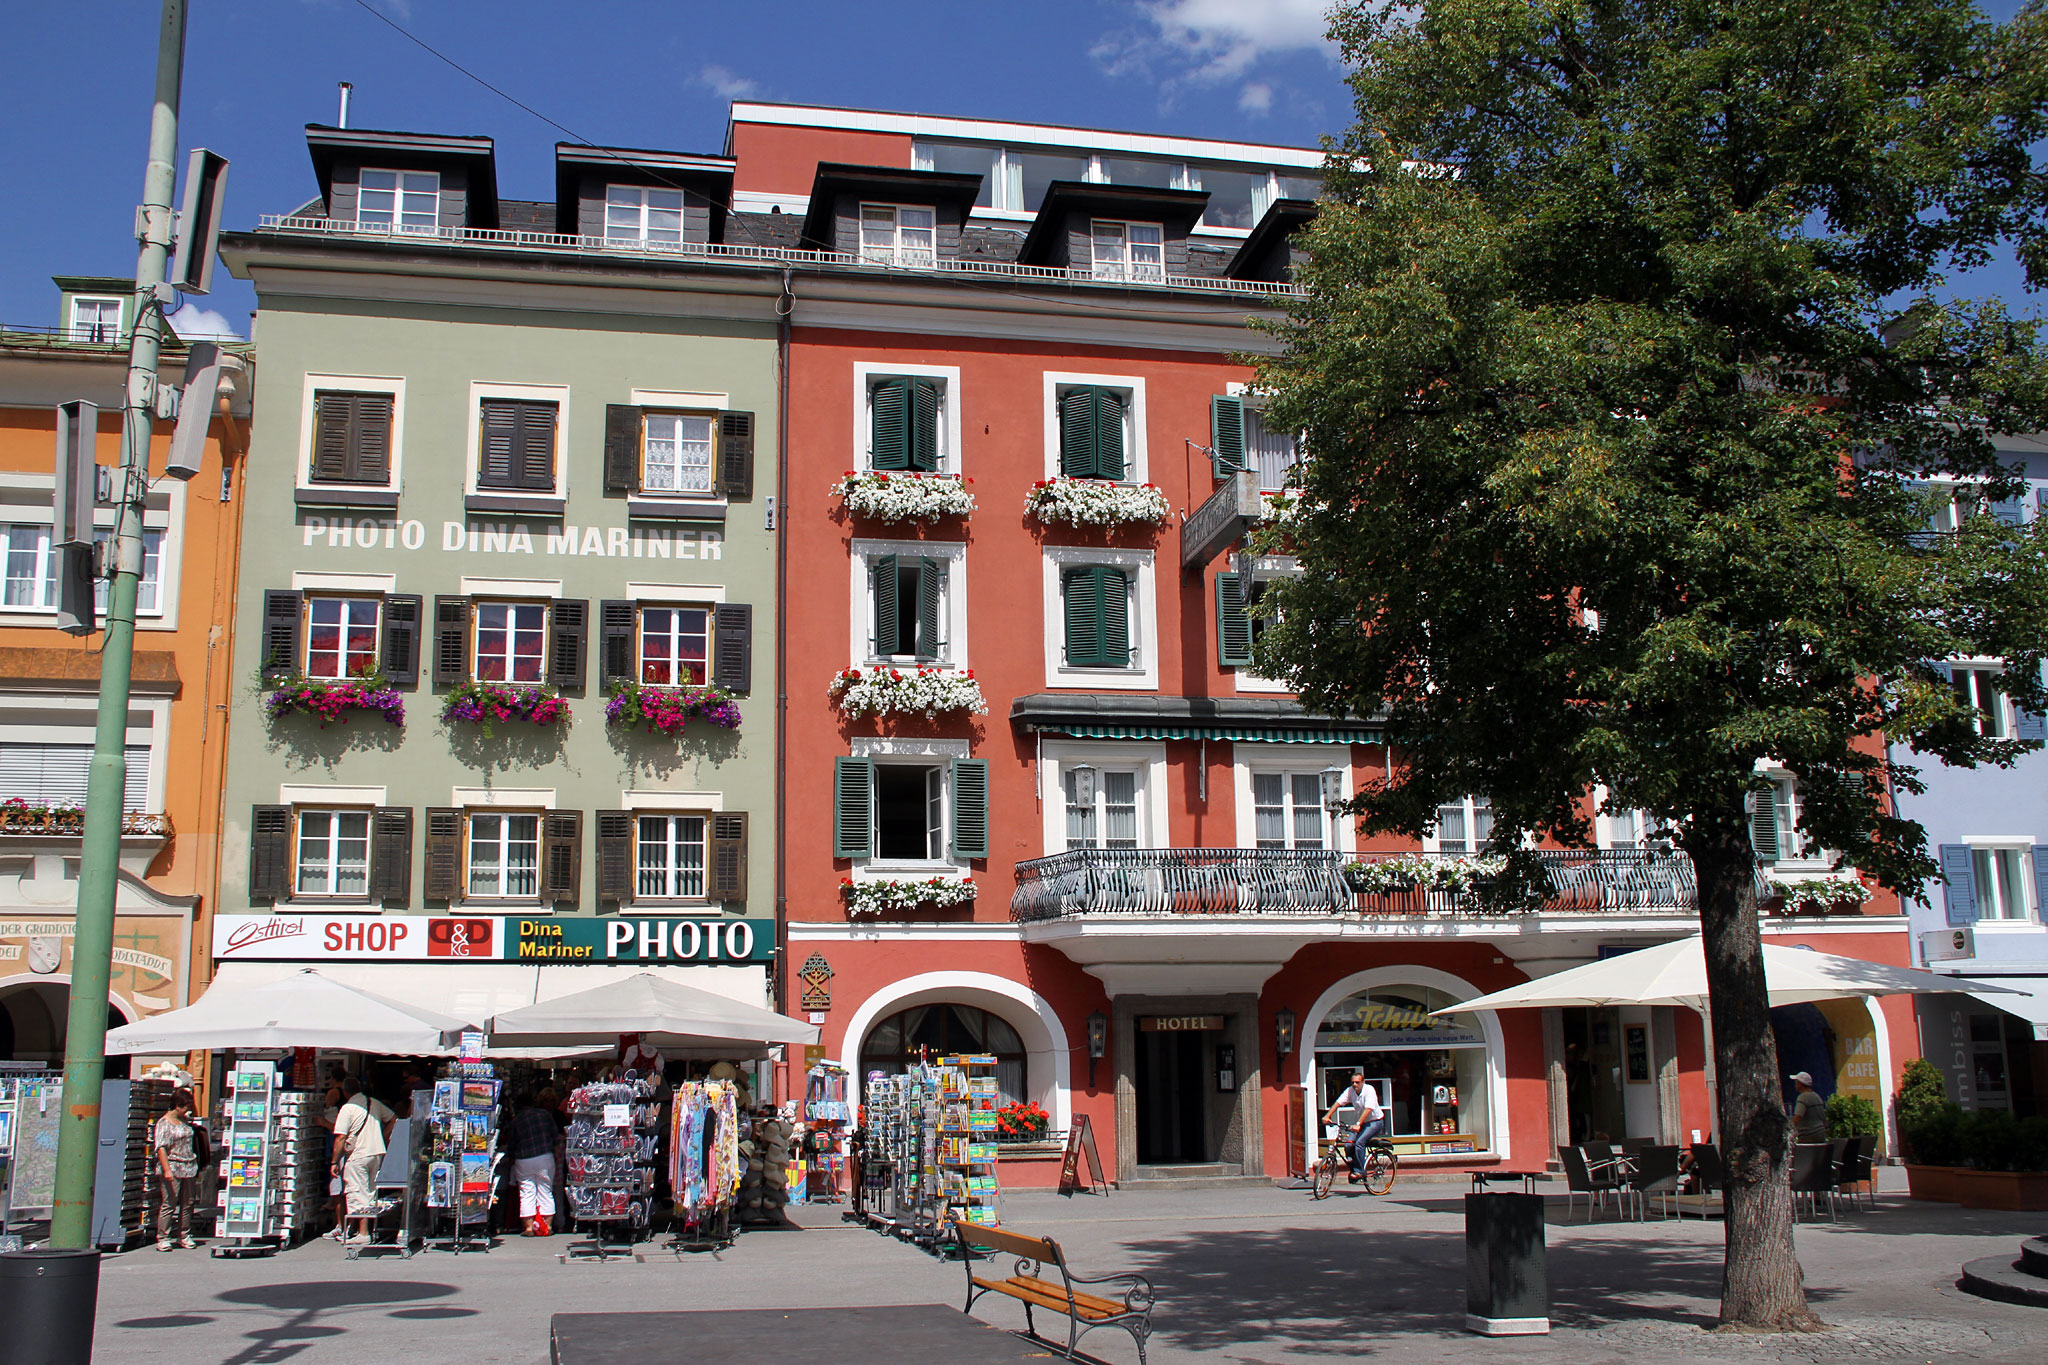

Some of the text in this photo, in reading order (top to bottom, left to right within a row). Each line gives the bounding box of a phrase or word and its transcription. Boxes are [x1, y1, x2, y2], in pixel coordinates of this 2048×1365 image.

[303, 515, 722, 561] PHOTO DINA MARINER
[1, 923, 77, 935] DER GRUNDSTE
[225, 917, 304, 950] Osttirol
[323, 922, 408, 952] SHOP
[519, 920, 563, 936] Dina
[606, 920, 754, 959] PHOTO
[450, 943, 470, 956] KG
[519, 941, 593, 958] Mariner
[1156, 1017, 1208, 1030] HOTEL
[1355, 1005, 1440, 1030] Tchibo
[1845, 1037, 1874, 1055] BAR
[1847, 1060, 1876, 1078] CAFÉ
